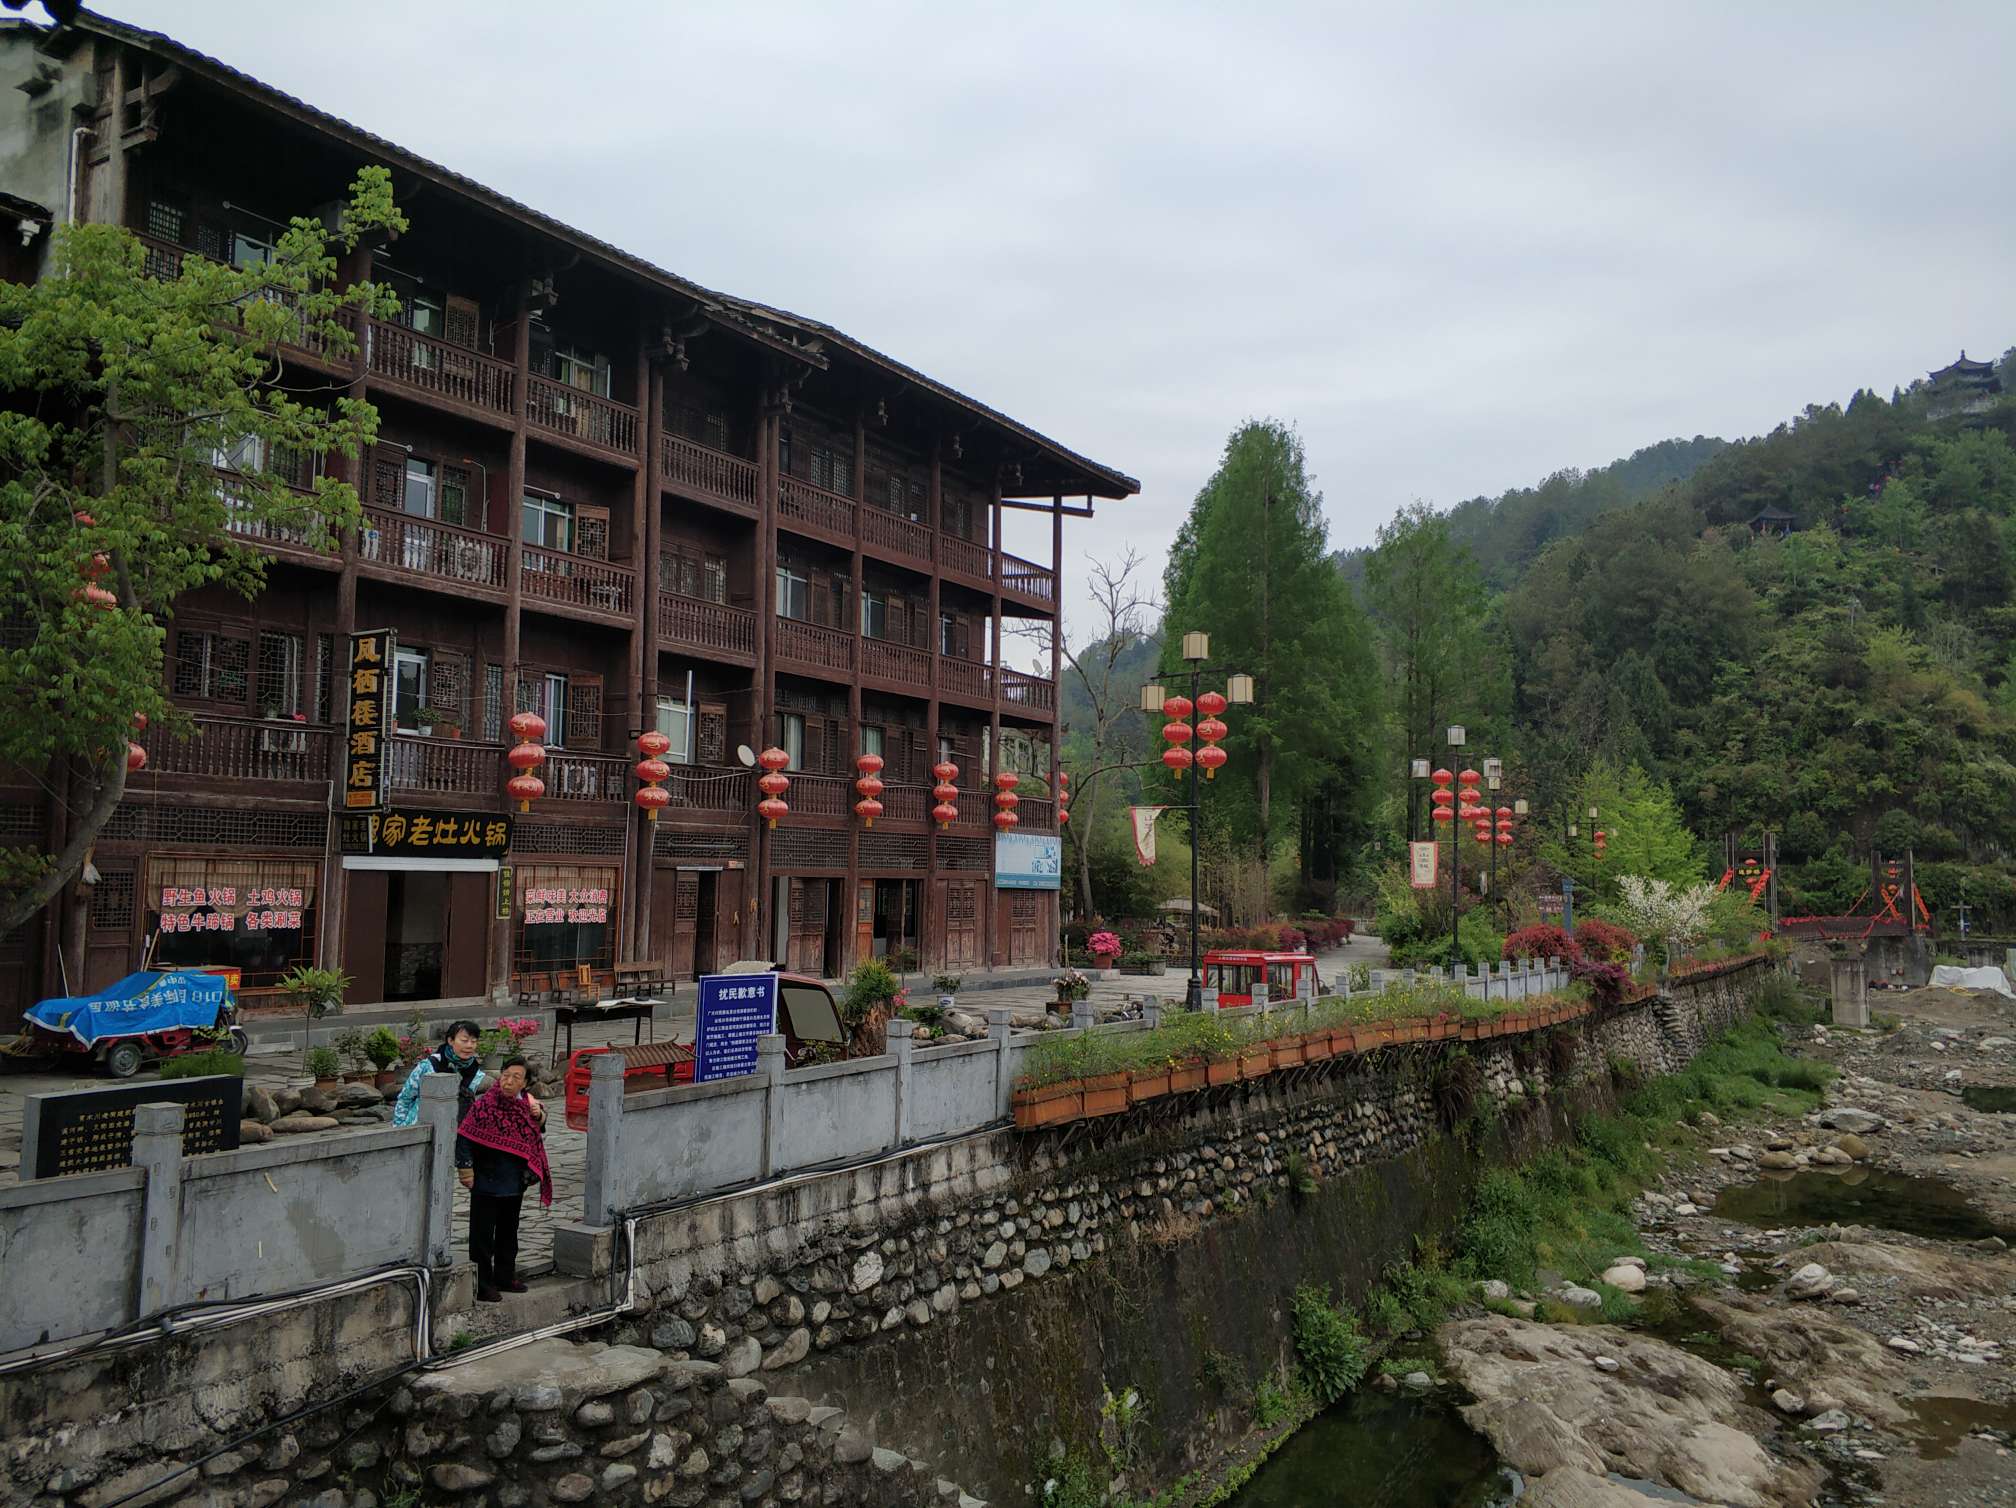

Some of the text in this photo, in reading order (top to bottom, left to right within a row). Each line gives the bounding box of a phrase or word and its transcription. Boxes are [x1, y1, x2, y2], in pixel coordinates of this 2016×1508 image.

[163, 888, 302, 906] 野生鱼火锅 土鸡火锅
[525, 888, 608, 904] 菜鲜味美 大众消费
[161, 911, 302, 933] 特色牛蹄锅 各类涮菜
[525, 908, 607, 924] 正在营业 欢迎光临
[718, 986, 765, 1001] 扰民歉意书
